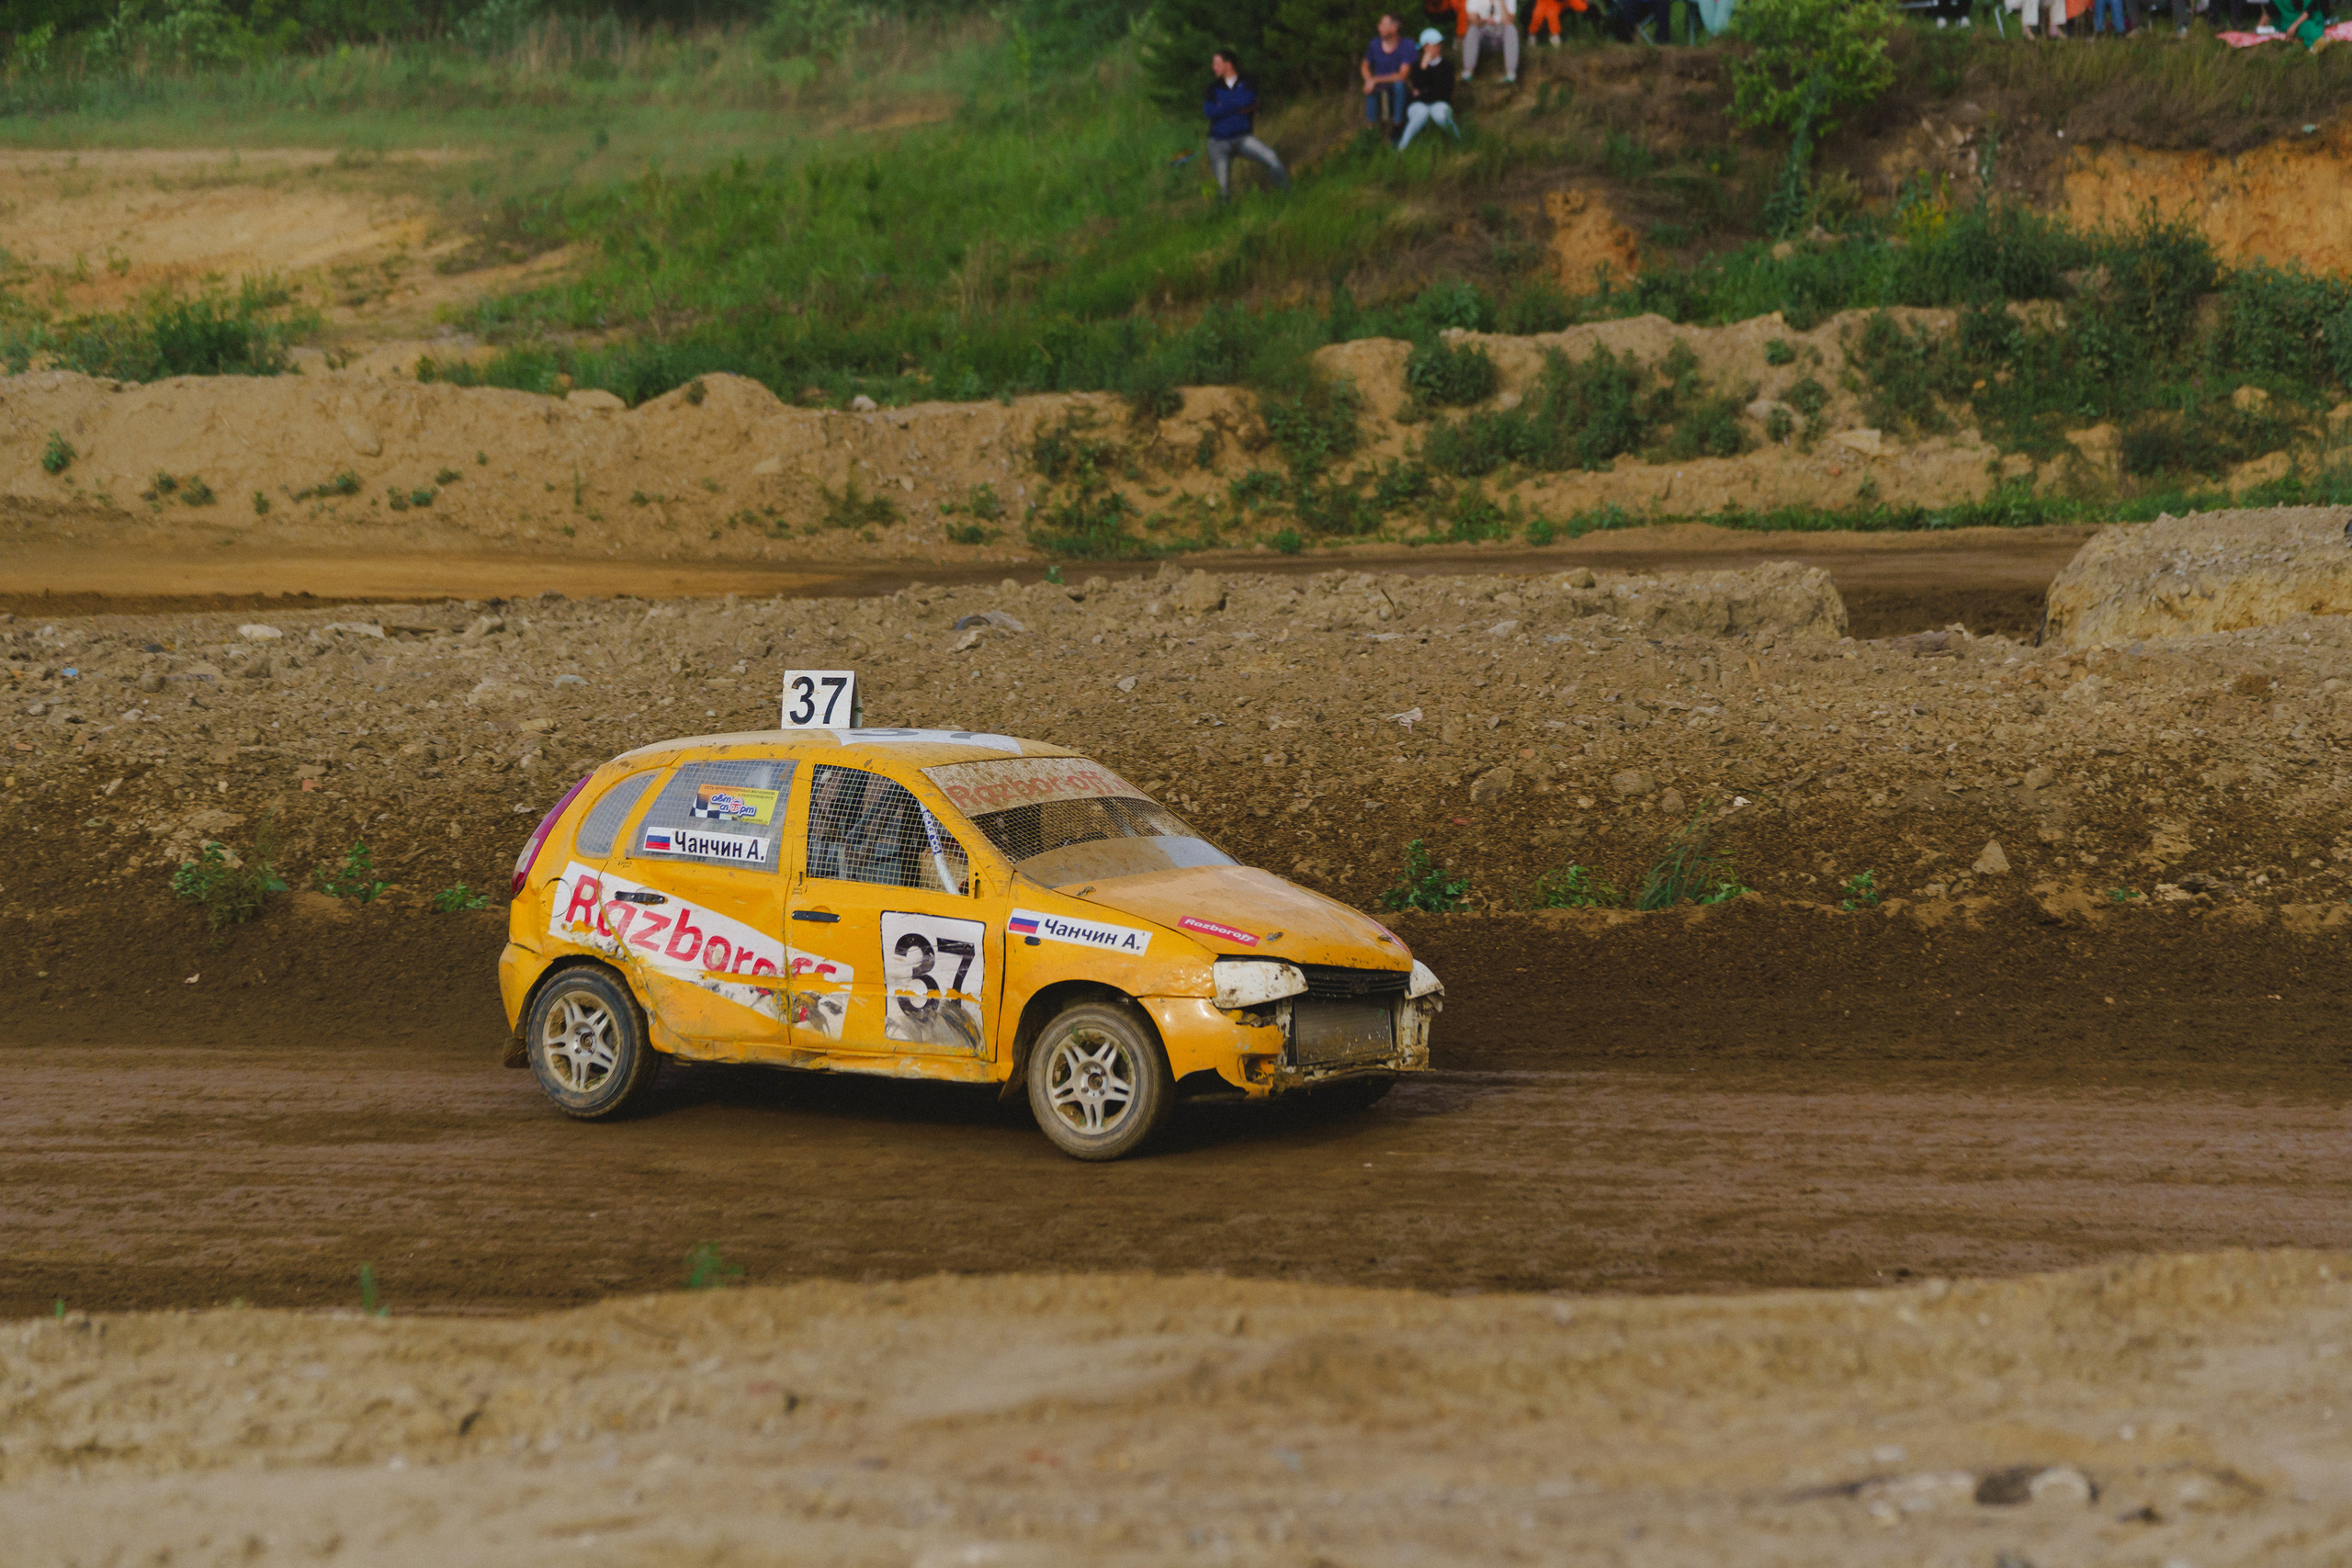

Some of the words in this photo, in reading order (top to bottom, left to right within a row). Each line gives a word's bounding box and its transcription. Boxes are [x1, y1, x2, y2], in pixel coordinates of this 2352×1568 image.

[789, 676, 847, 725] 37
[674, 830, 743, 858] Чанчин
[746, 839, 764, 861] А.
[1044, 919, 1118, 945] Чанчин
[1121, 933, 1141, 951] А.
[1184, 918, 1255, 942] Razboroff
[894, 932, 976, 1023] 37
